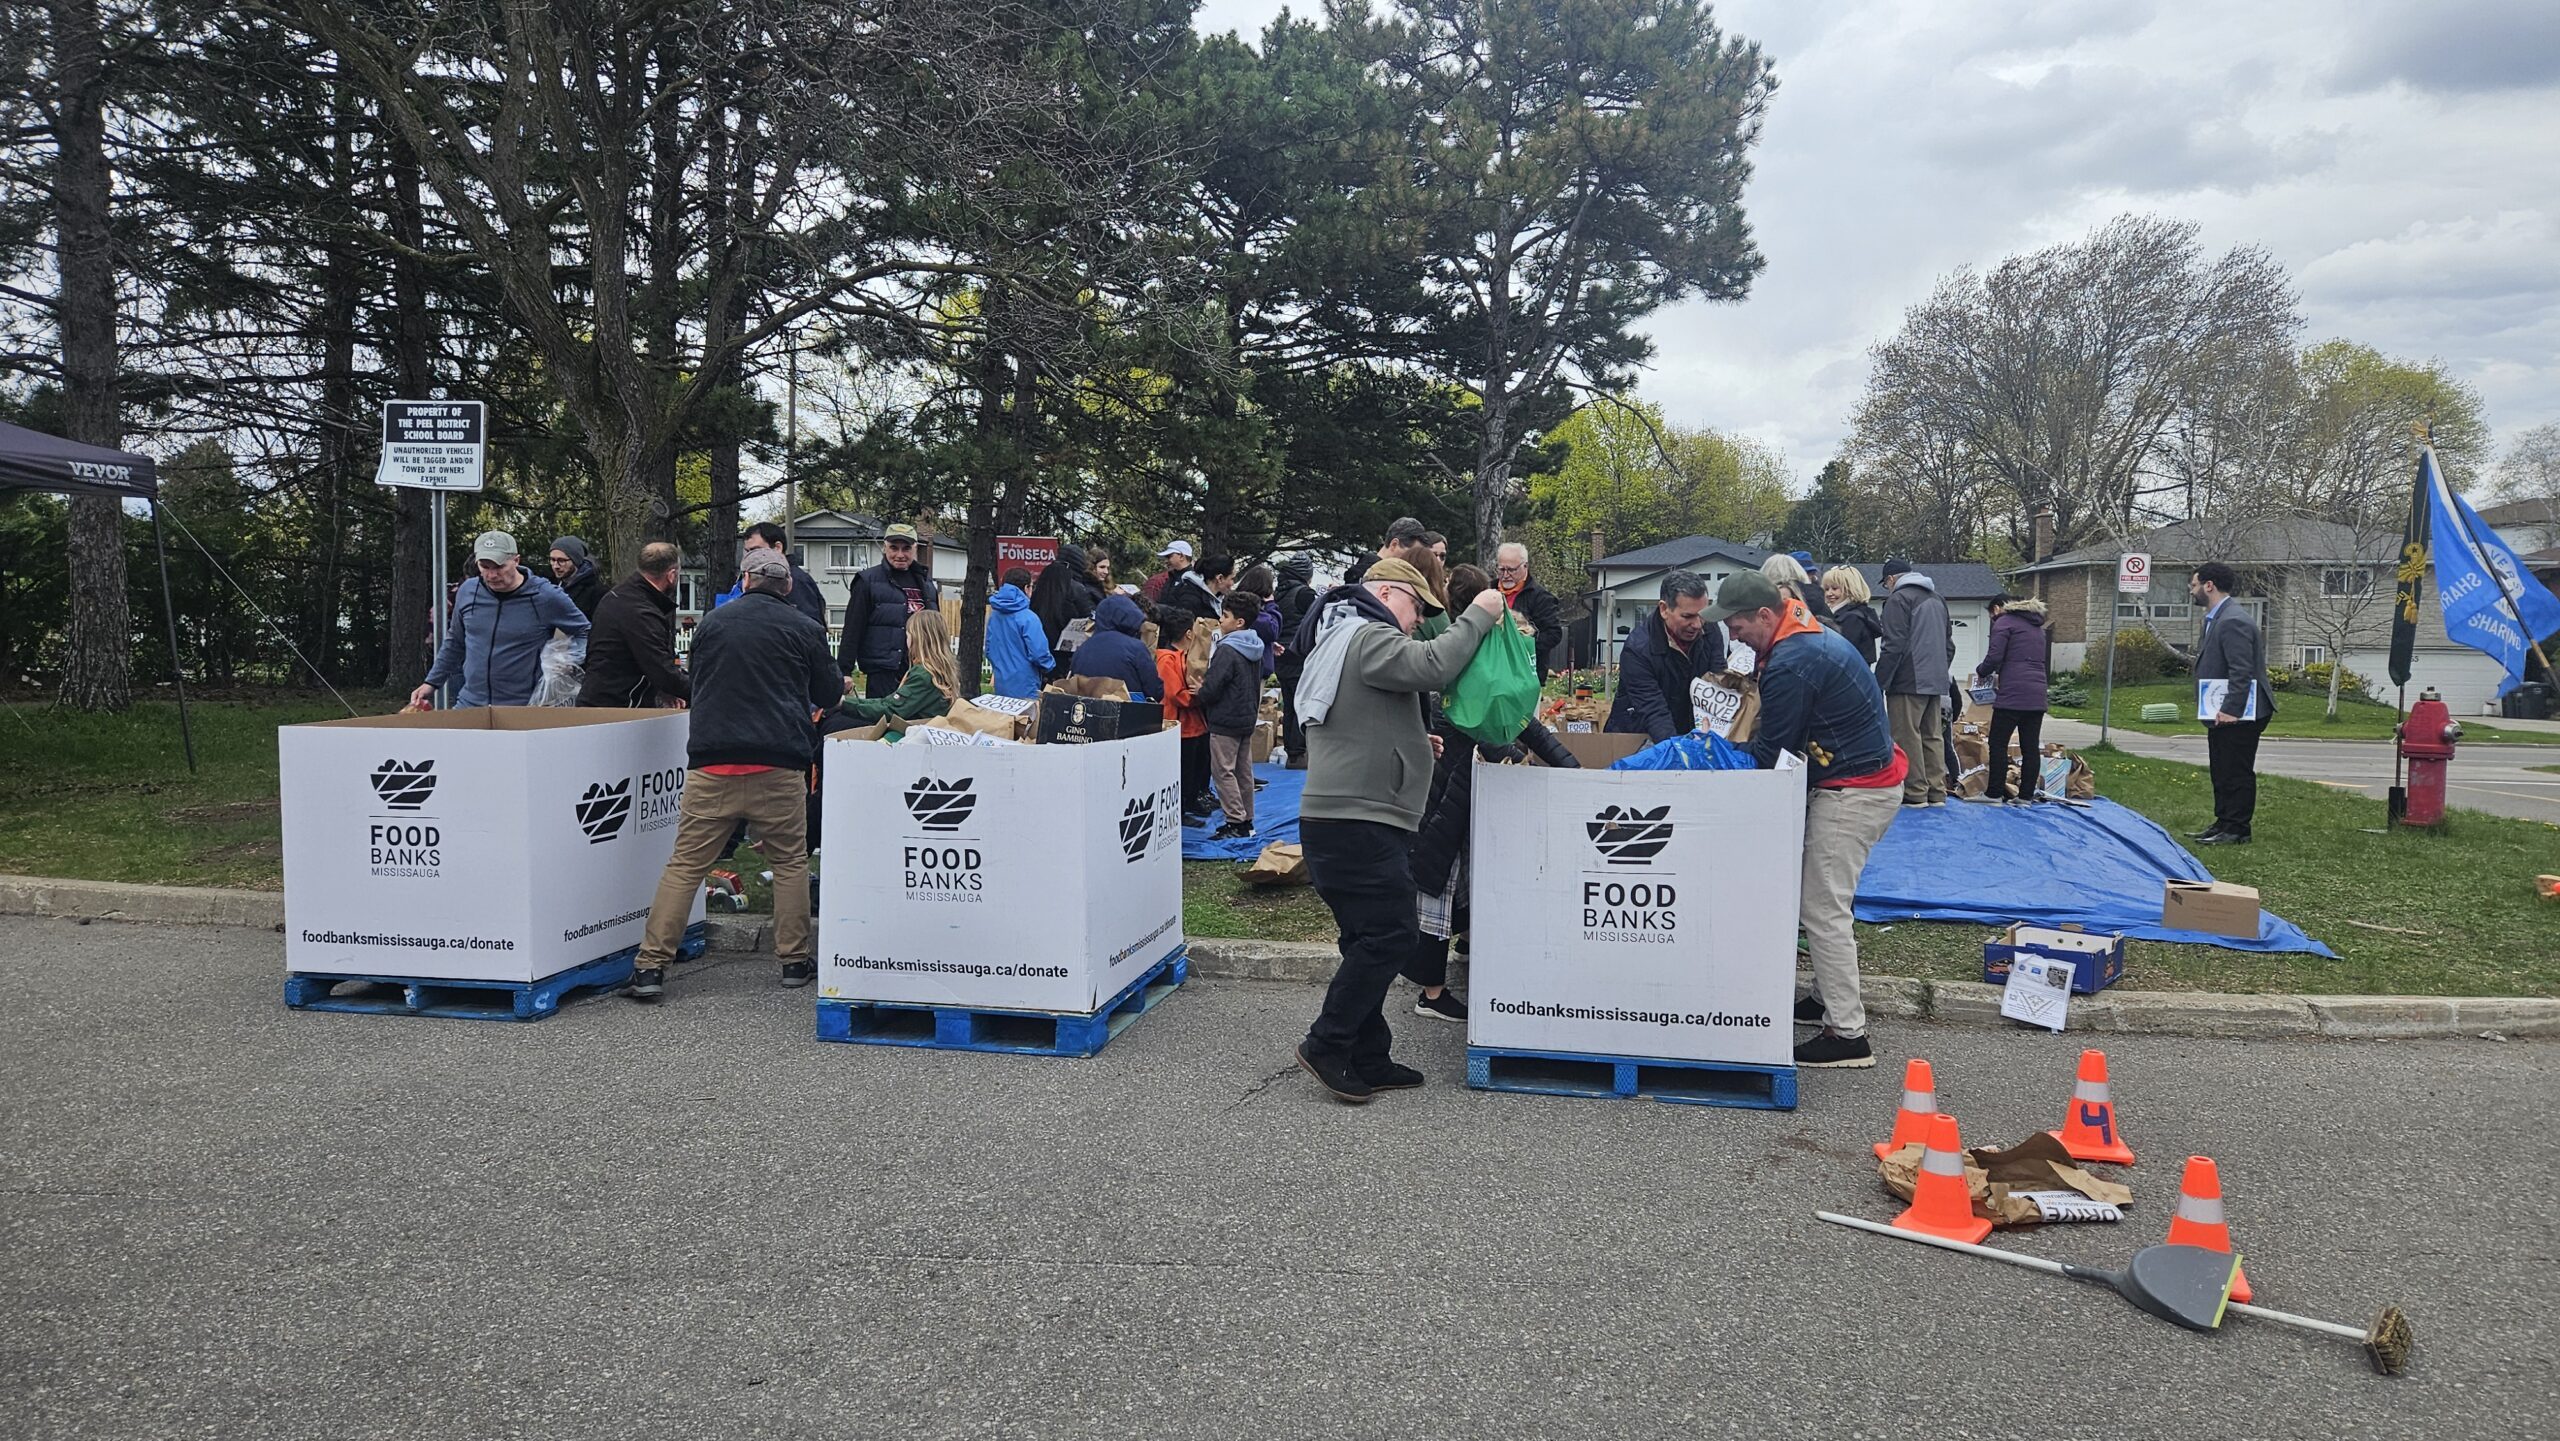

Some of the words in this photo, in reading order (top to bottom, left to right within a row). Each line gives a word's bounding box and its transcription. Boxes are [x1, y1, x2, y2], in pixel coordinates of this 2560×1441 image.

[407, 407, 448, 417] PROPERTY
[451, 407, 462, 417] OF
[398, 419, 413, 428] THE
[416, 419, 433, 429] PEEL
[436, 419, 471, 429] DISTRICT
[403, 430, 435, 440] SCHOOL
[436, 430, 465, 440] BOARD
[393, 446, 443, 455] UNAUTHORIZED
[445, 447, 474, 455] VEHICLES
[393, 456, 409, 464] WILL
[412, 456, 420, 464] BE
[423, 456, 447, 465] TAGGED
[449, 457, 474, 465] AND/OR
[402, 465, 426, 474] TOWED
[428, 466, 436, 474] AT
[438, 466, 465, 475] OWNERS
[67, 461, 130, 481] VEVOR
[420, 475, 448, 484] EXPENSE
[998, 542, 1057, 561] FONSECA
[2467, 611, 2522, 651] SHARING
[1693, 683, 1739, 708] FOOD
[979, 699, 1023, 713] FOOD
[1693, 695, 1734, 719] DRIVE
[1065, 726, 1087, 736] GINO
[1568, 722, 1590, 731] FOOD
[928, 728, 971, 746] FOOD
[1056, 732, 1094, 745] BAMBINO
[642, 766, 685, 798] FOOD
[1160, 780, 1180, 814] FOOD
[640, 814, 681, 833] MISSISSAUG
[1158, 806, 1179, 838] BANKS
[371, 825, 440, 847] FOOD
[371, 848, 441, 867] BANKS
[904, 846, 982, 870] FOOD
[371, 867, 441, 878] MISSISSAUGA
[904, 870, 983, 891] BANKS
[905, 890, 983, 904] MISSISSAUGA
[1584, 881, 1676, 908] FOOD
[563, 906, 652, 942] foodbanksmississaug
[1583, 908, 1677, 930] BANKS
[302, 929, 515, 951] foodbanksmississauga.ca/donate
[1583, 930, 1676, 944] MISSISSAUGA
[833, 953, 1069, 978] foodbanksmississauga.ca/donate
[1489, 998, 1772, 1028] foodbanksmississauga.ca/donate
[2081, 1103, 2112, 1146] 4
[2046, 1206, 2118, 1222] DRIVE
